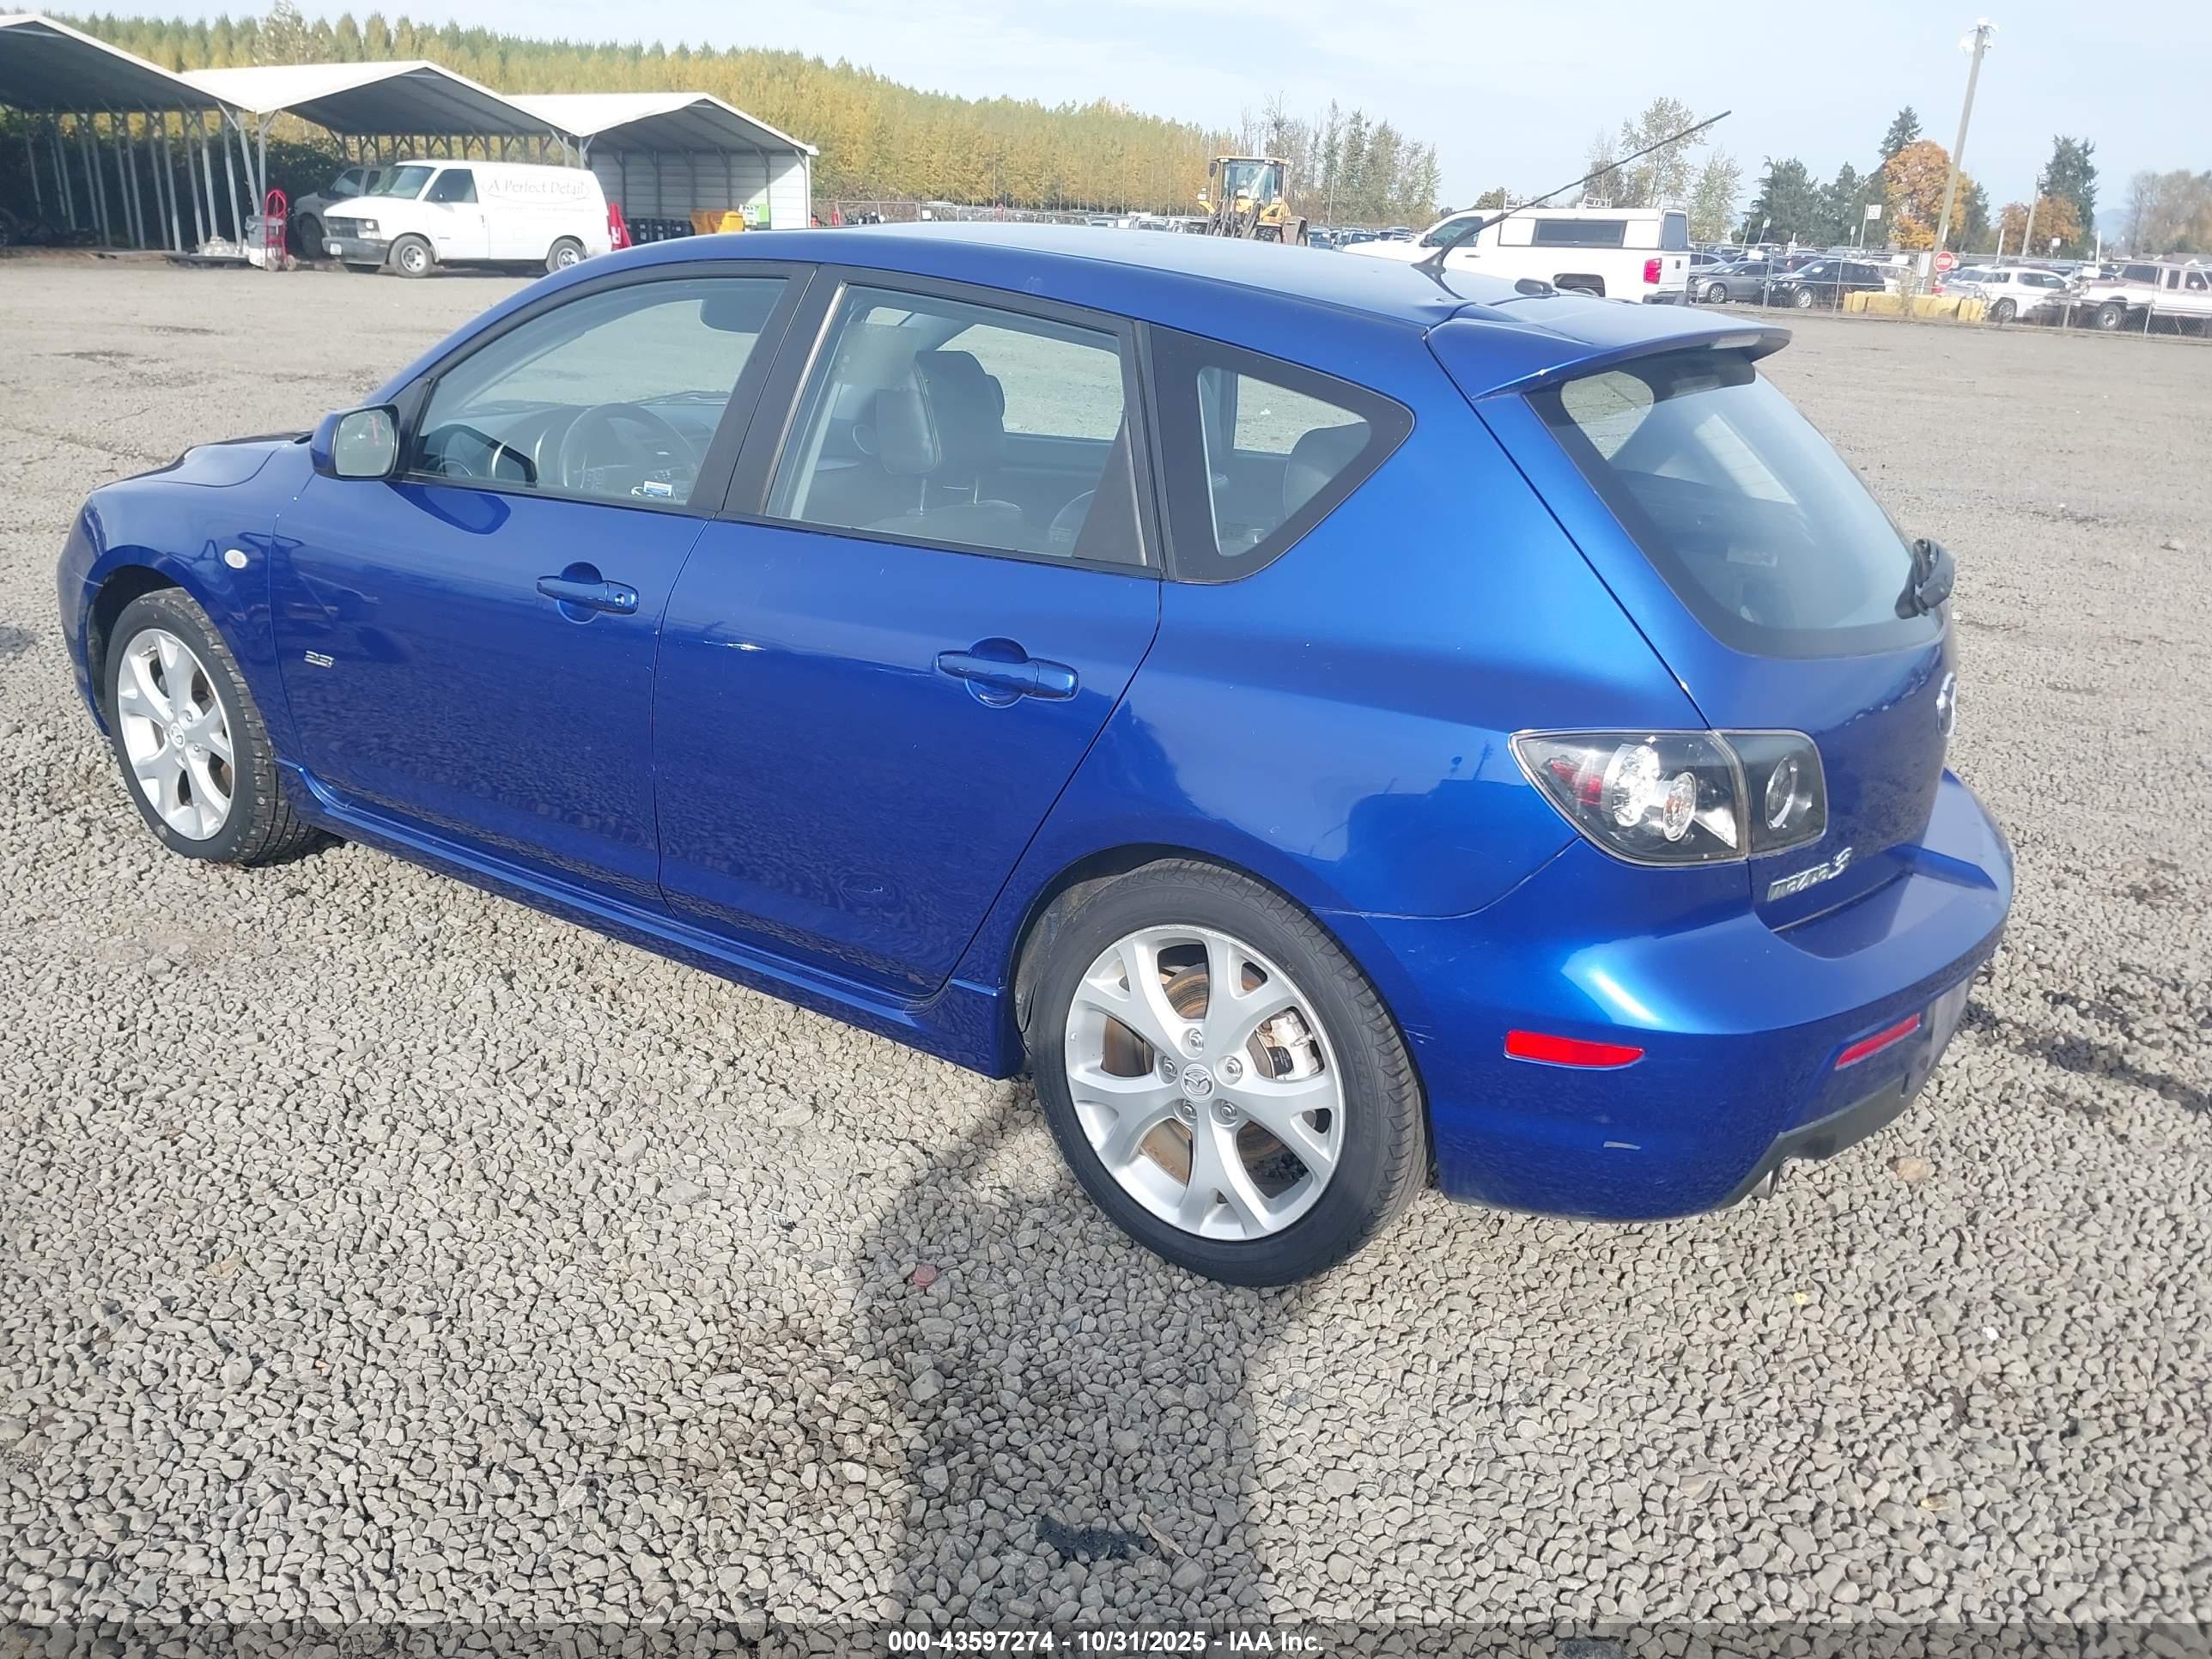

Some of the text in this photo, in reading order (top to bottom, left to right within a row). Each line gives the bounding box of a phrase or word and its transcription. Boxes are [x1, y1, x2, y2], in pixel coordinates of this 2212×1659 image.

[486, 178, 586, 196] A Perfect Detail
[1936, 258, 1953, 266] STOP
